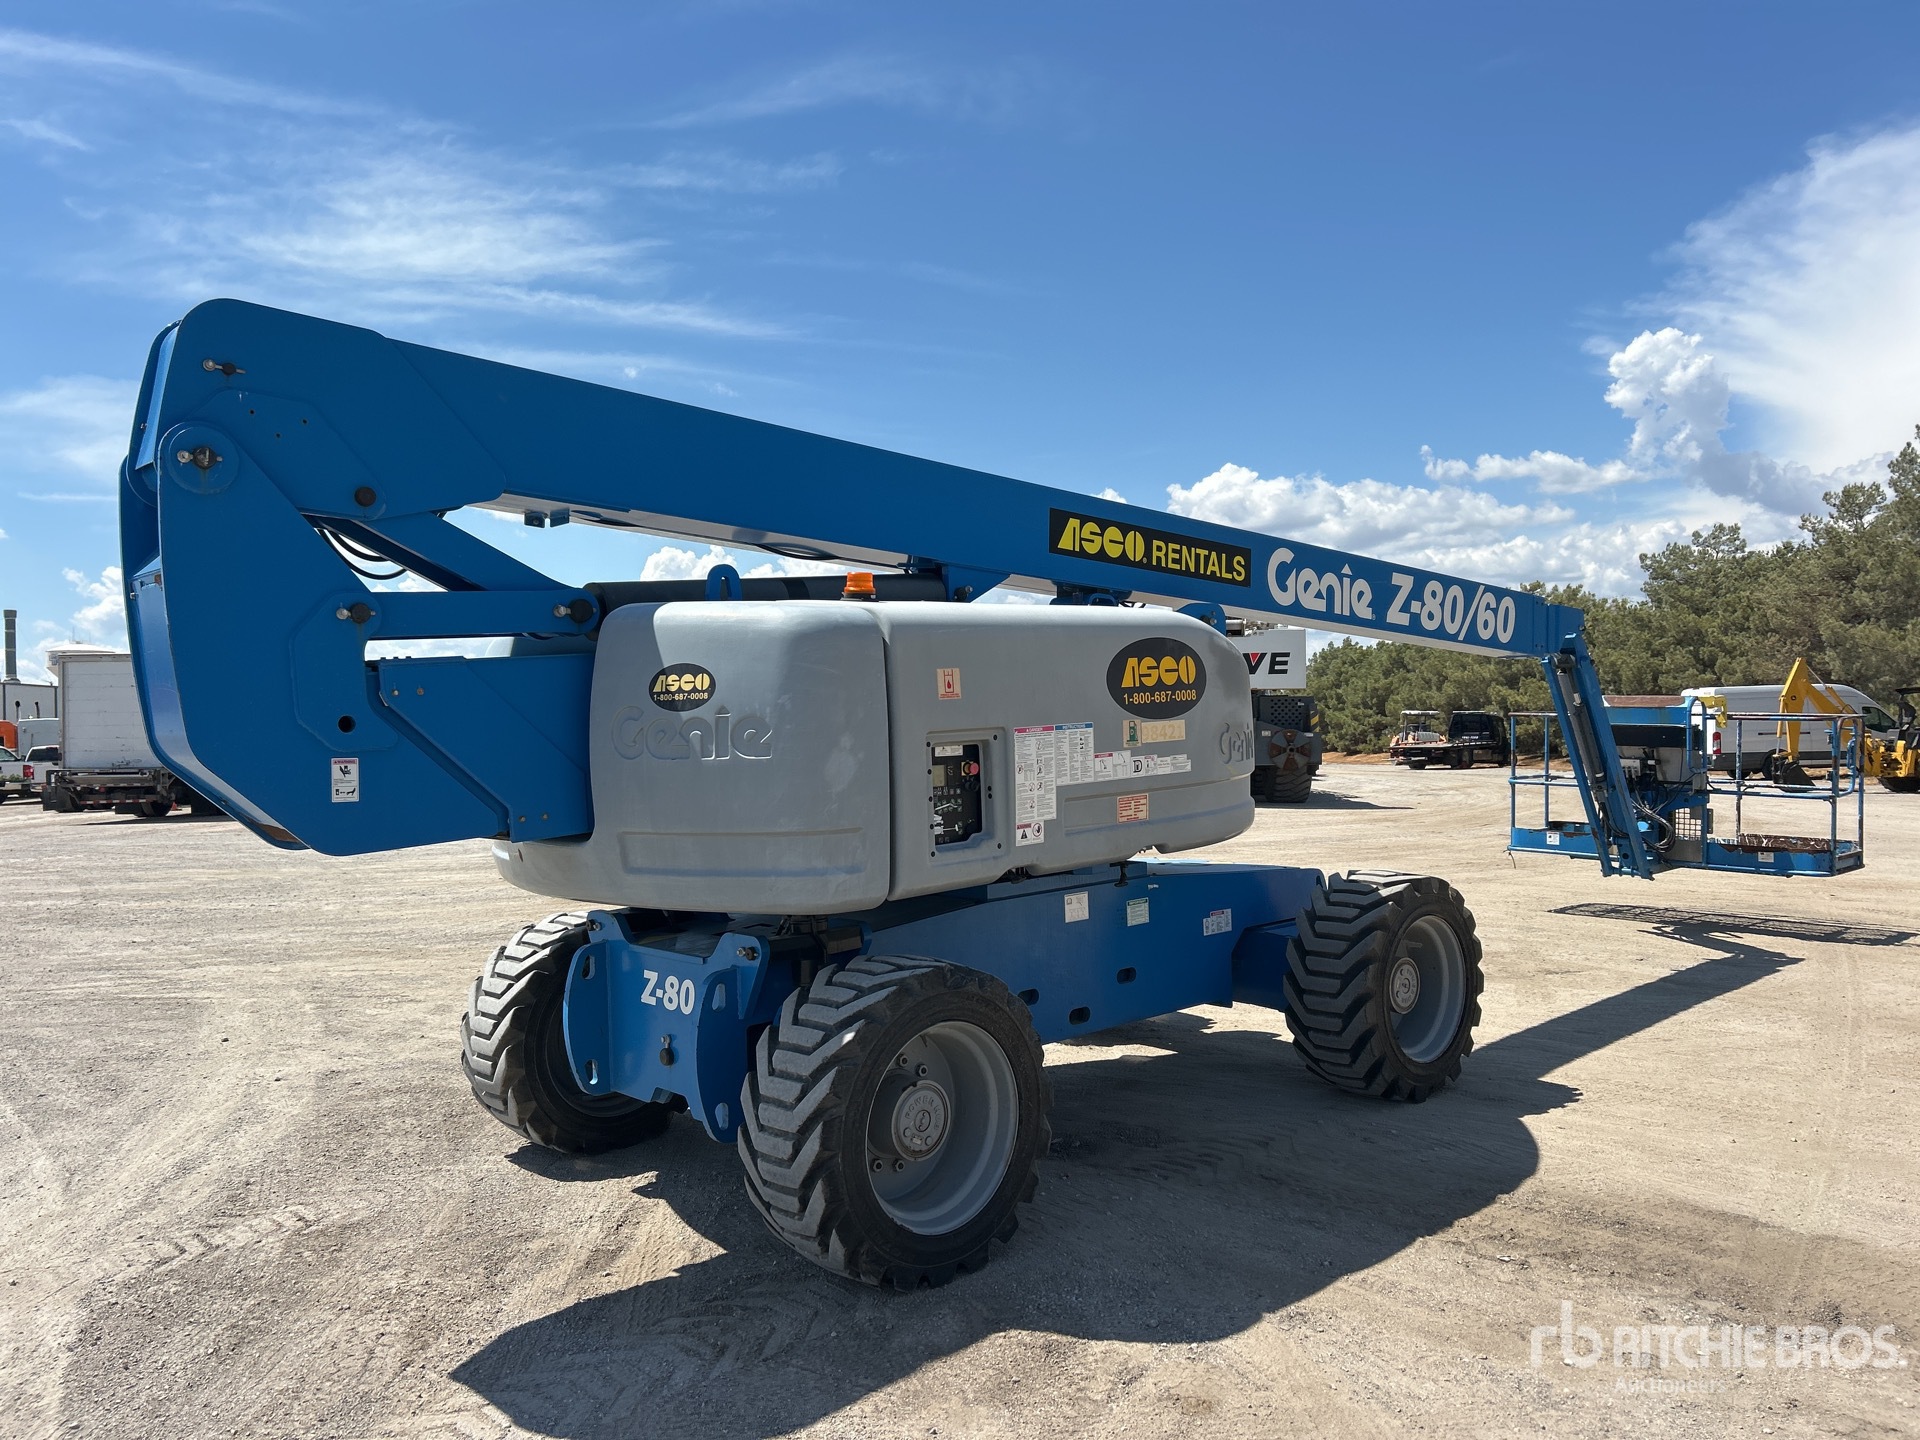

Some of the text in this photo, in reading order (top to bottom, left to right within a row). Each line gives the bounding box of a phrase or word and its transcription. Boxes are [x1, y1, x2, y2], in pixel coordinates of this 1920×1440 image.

[1057, 517, 1246, 582] ASCO RENTALS
[1267, 547, 1516, 644] Genie Z-80/60
[652, 673, 711, 692] ASCO
[1121, 655, 1196, 688] ASCO
[653, 692, 709, 701] 1-800-687-0008
[1123, 689, 1197, 705] 1-800-687-0008
[611, 704, 773, 761] Genie
[640, 969, 695, 1015] Z-80
